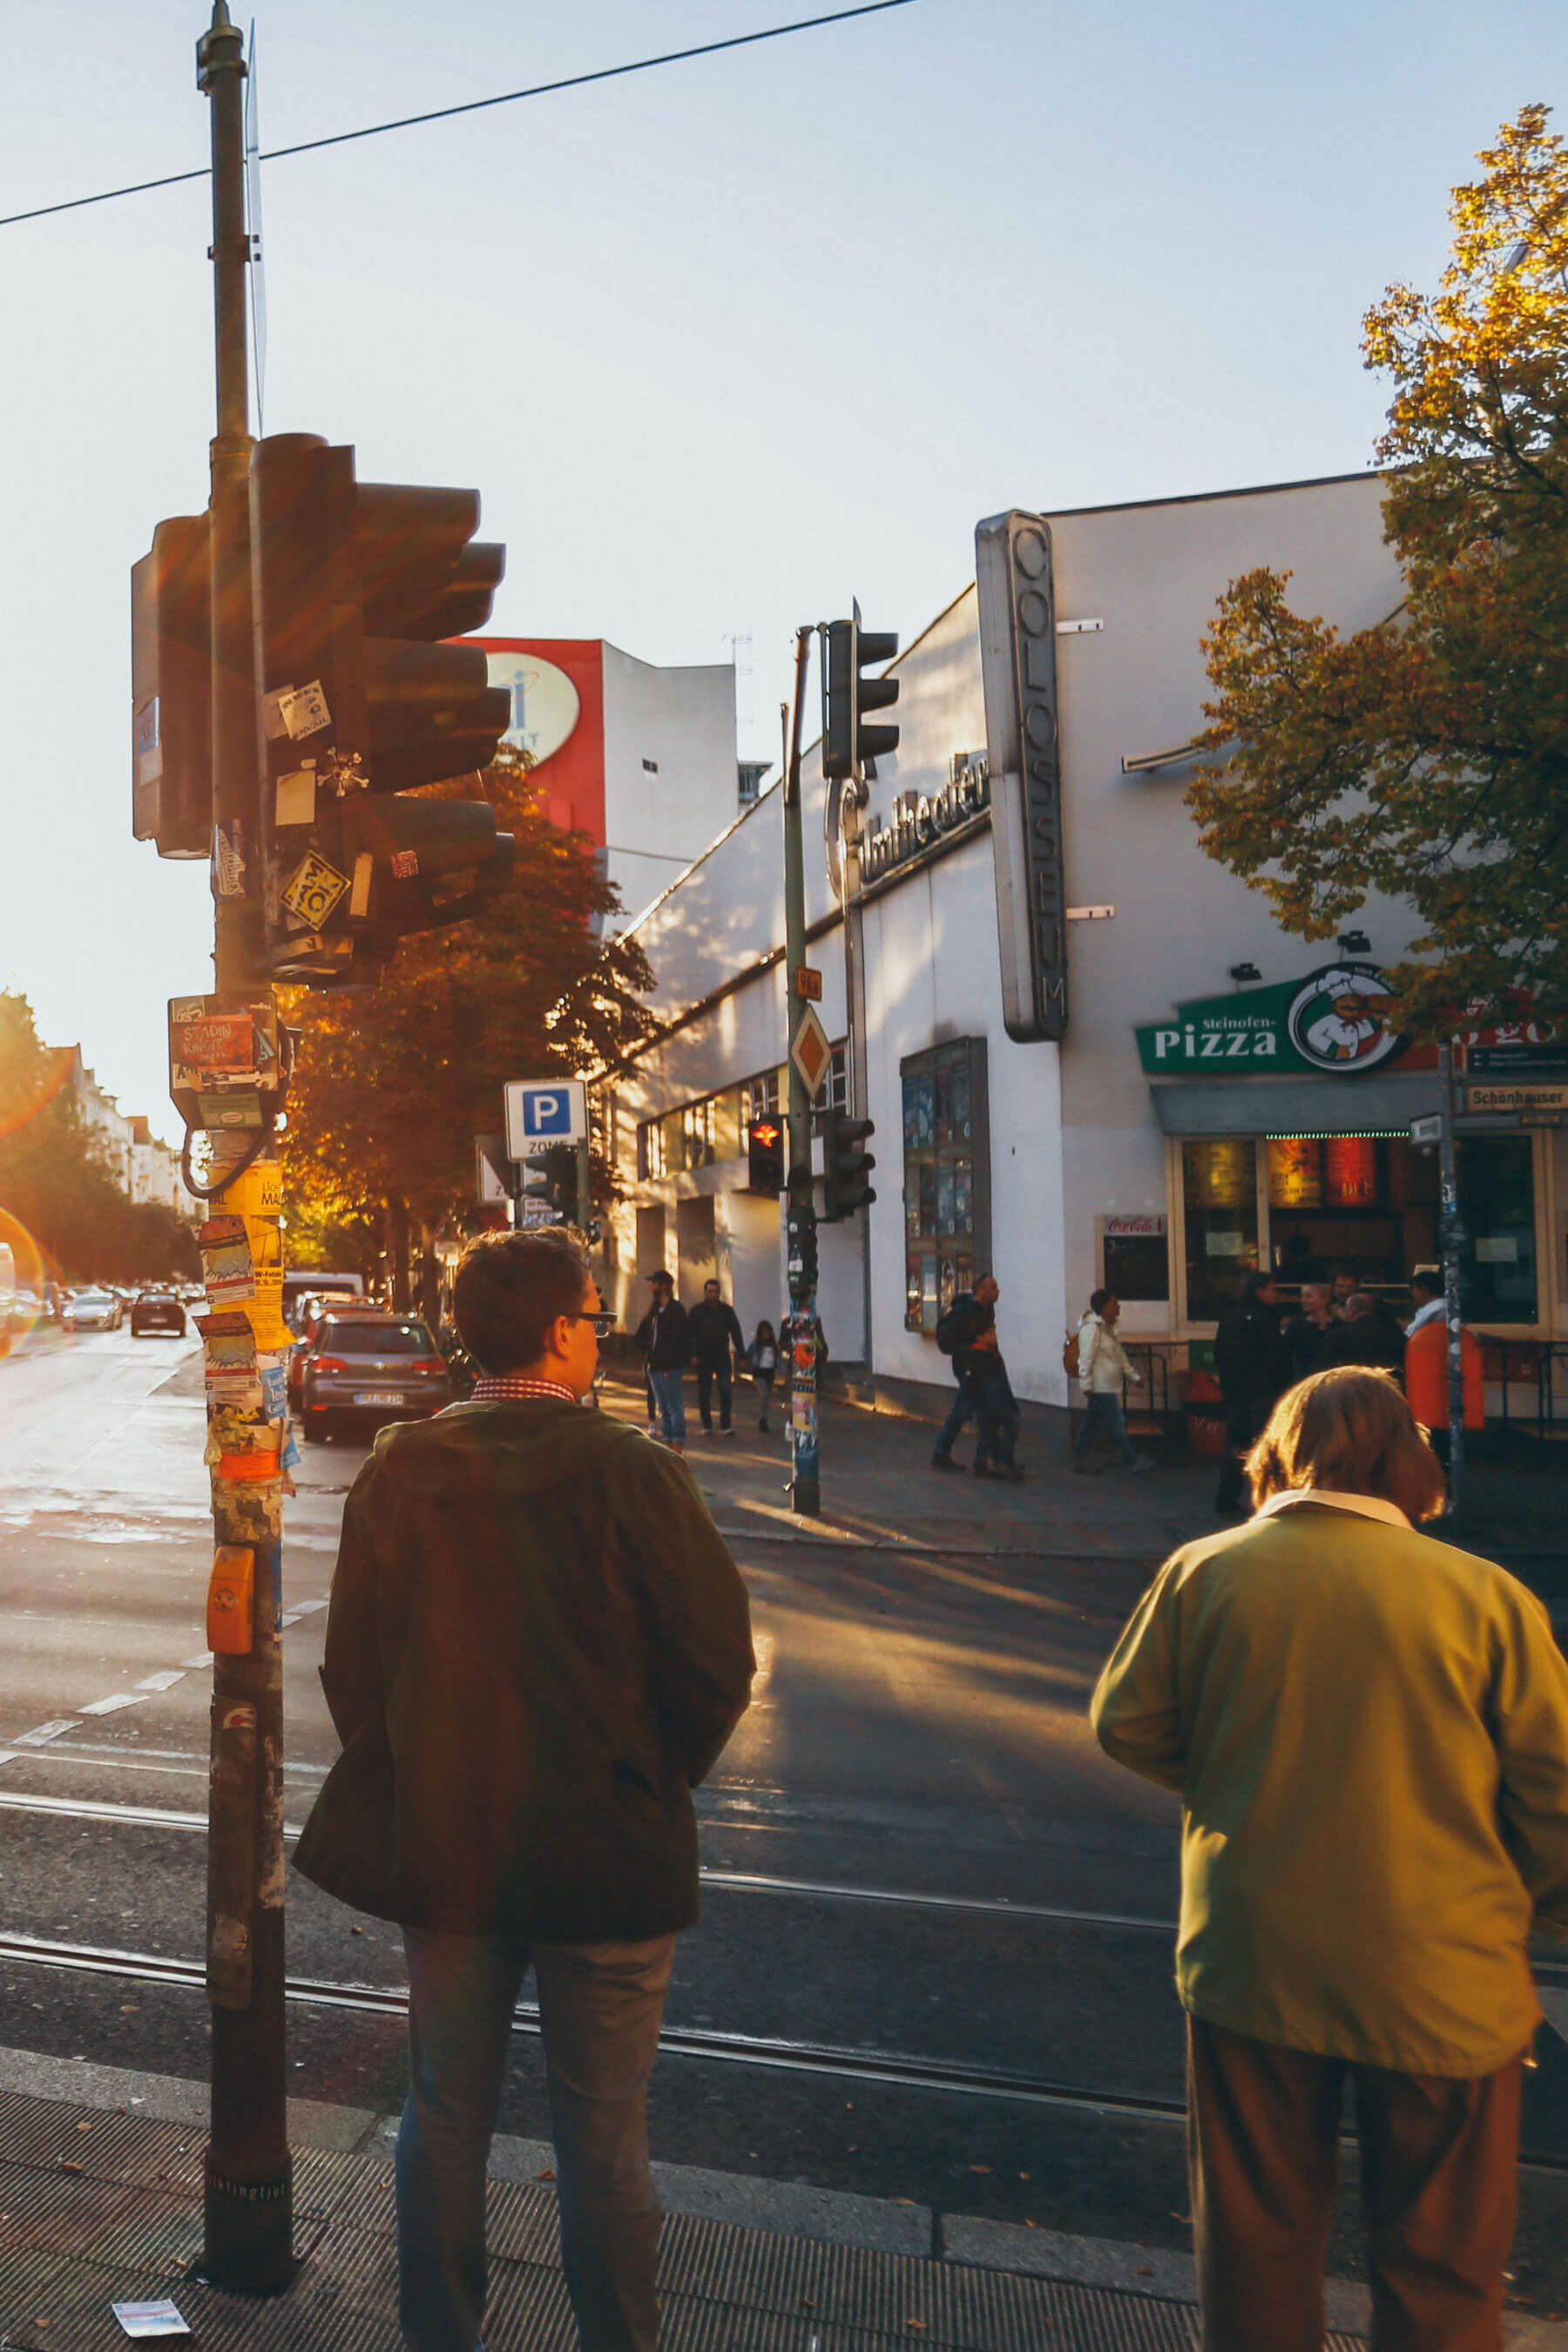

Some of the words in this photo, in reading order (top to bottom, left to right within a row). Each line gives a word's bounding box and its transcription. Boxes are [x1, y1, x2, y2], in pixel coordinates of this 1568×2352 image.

[1013, 526, 1064, 1017] COLOSSEUM
[1155, 1024, 1277, 1058] Pizza
[534, 1095, 559, 1131] P
[1473, 1090, 1565, 1105] Schönhauser
